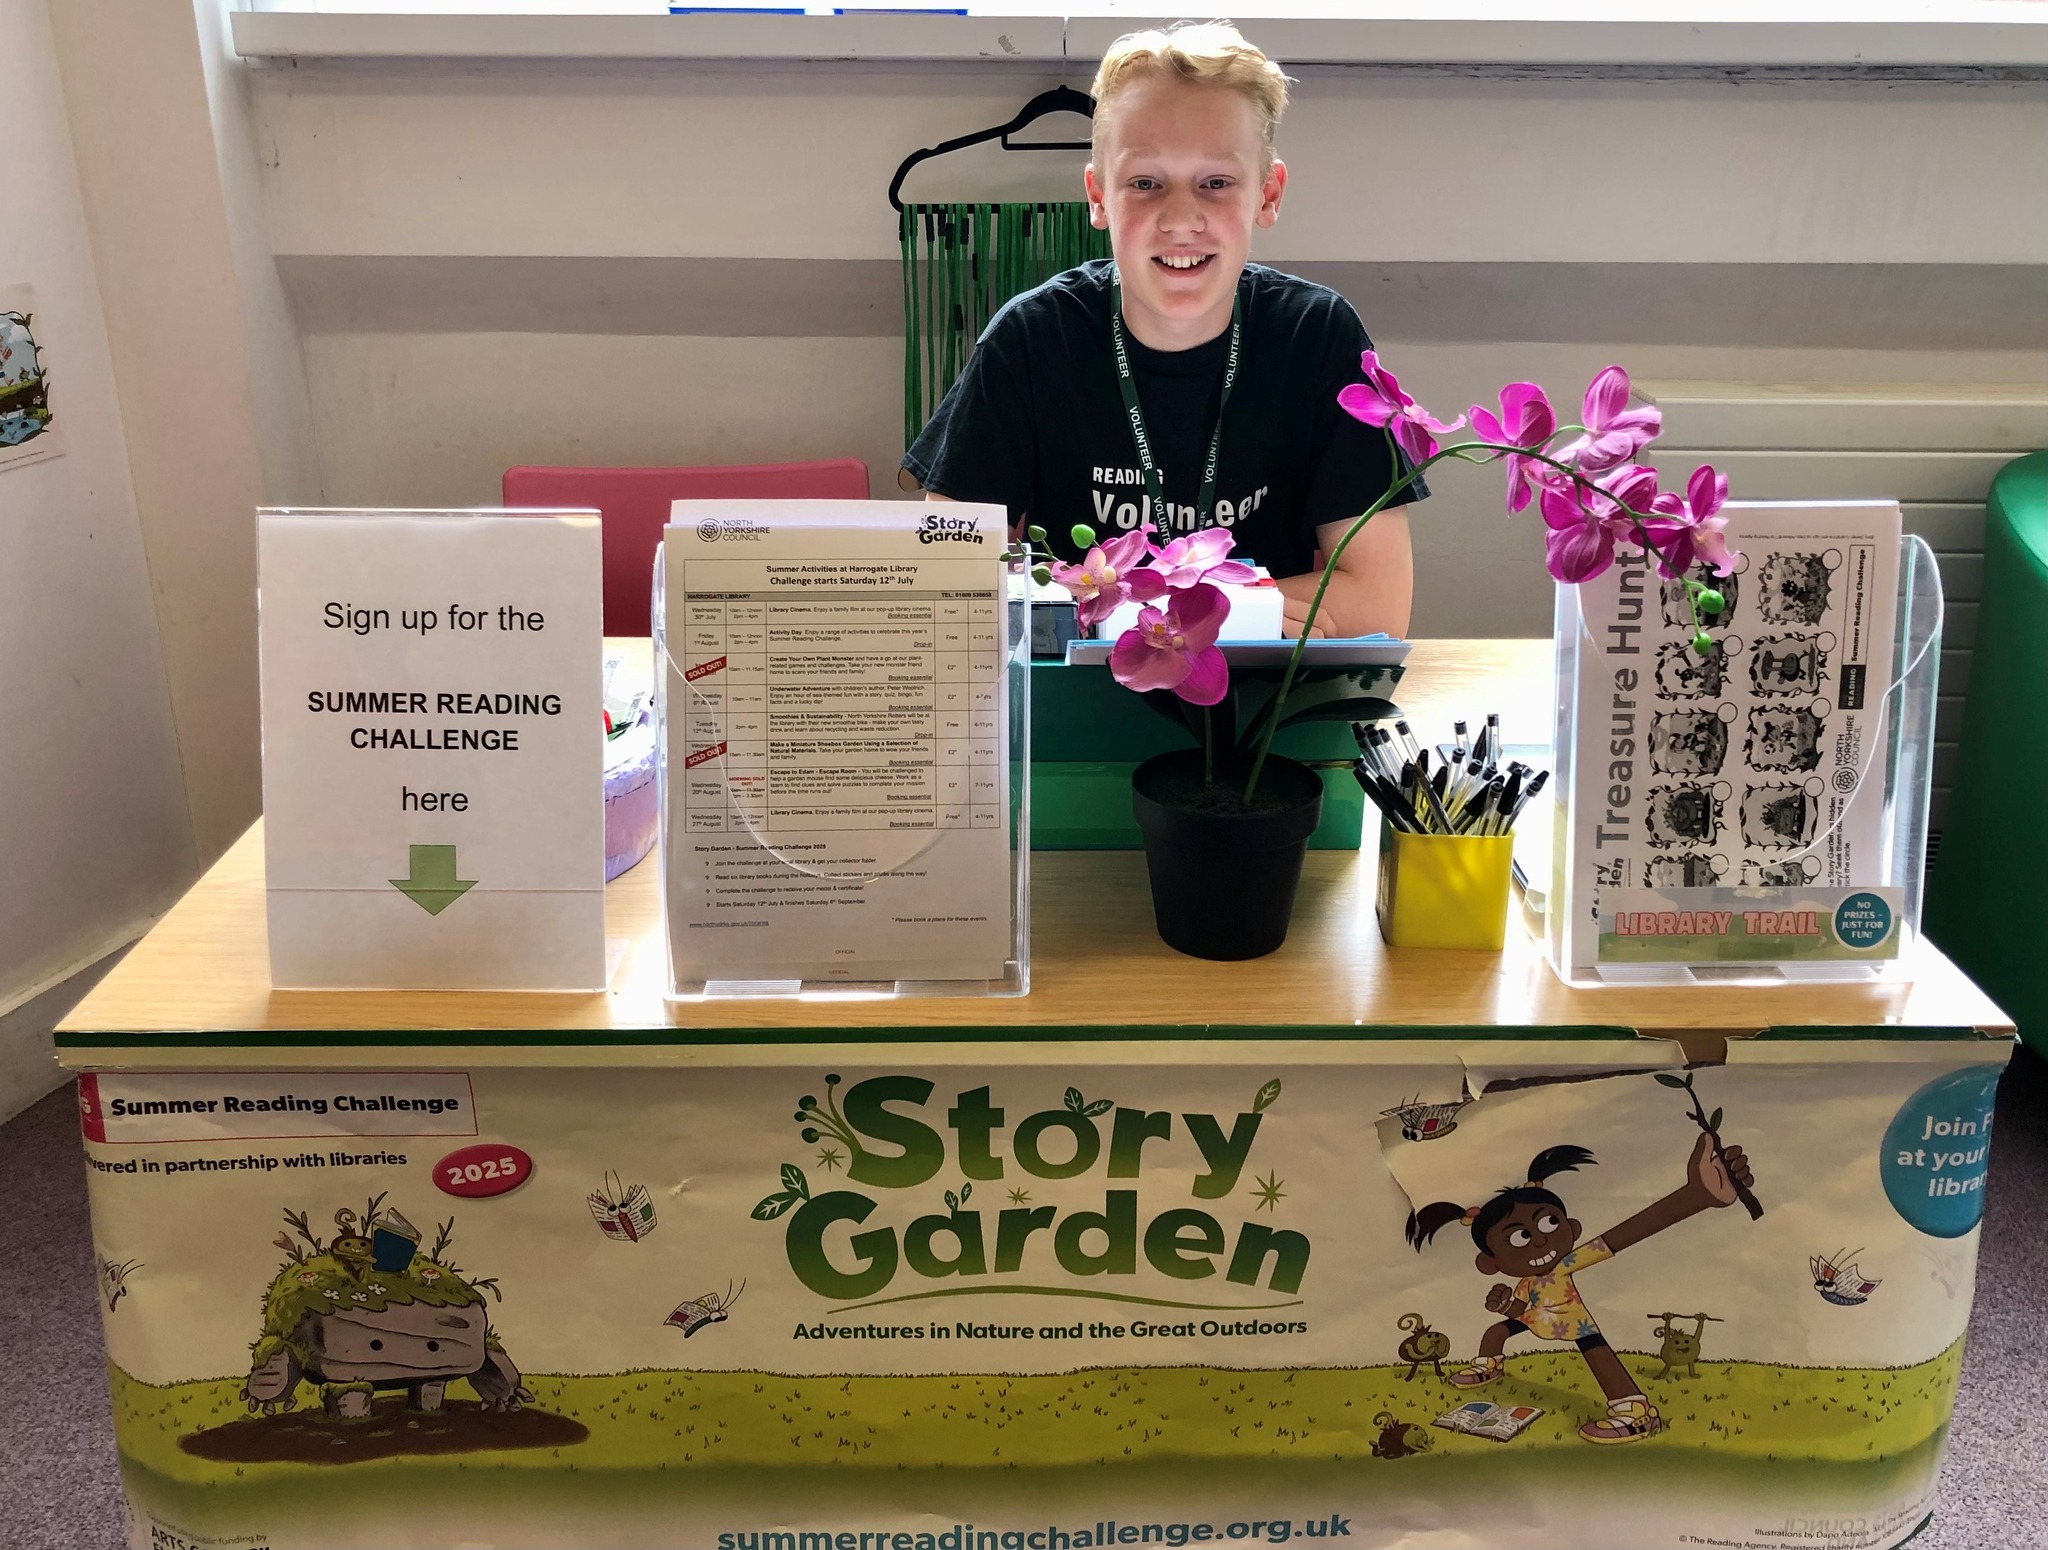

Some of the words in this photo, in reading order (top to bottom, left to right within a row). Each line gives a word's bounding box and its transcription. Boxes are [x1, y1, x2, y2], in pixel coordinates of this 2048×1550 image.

[1112, 312, 1129, 378] VOLUNTEER
[1225, 323, 1240, 388] VOLUNTEER
[1129, 406, 1152, 471] VOLUNTEER
[926, 515, 979, 532] Story
[1154, 496, 1171, 545] VOLUNTE
[919, 530, 983, 544] Garden
[770, 577, 811, 586] Challenge
[840, 577, 877, 585] Saturday
[880, 576, 895, 584] 12th
[898, 577, 914, 585] July
[801, 565, 837, 573] Activities
[890, 565, 917, 573] Library
[1856, 549, 1866, 594] Challenge
[1606, 551, 1648, 654] Hunt
[1854, 592, 1863, 626] Reading
[323, 602, 390, 636] Sign
[402, 606, 438, 636] up
[448, 604, 488, 631] for
[498, 605, 545, 631] the
[688, 667, 706, 679] SOLD
[1848, 668, 1857, 706] READING
[307, 691, 427, 714] SUMMER
[437, 693, 562, 716] READING
[350, 728, 519, 751] CHALLENGE
[1835, 734, 1844, 766] NORTH
[1843, 715, 1855, 766] YORKSHIRE
[1851, 725, 1862, 766] COUNCIL
[689, 753, 706, 764] SOLD
[1596, 668, 1638, 849] Treasure
[401, 786, 469, 812] here
[1615, 911, 1733, 936] LIBRARY
[1743, 911, 1820, 935] TRAIL
[1842, 921, 1862, 929] JUST
[1866, 921, 1883, 929] FOR
[1851, 931, 1873, 939] FUN!
[111, 1099, 218, 1116] Summer
[223, 1094, 328, 1114] Reading
[334, 1096, 459, 1113] Challenge
[840, 1075, 1264, 1199] Story
[1922, 1116, 1977, 1140] Join
[142, 1159, 160, 1172] in
[166, 1154, 279, 1175] partnership
[283, 1153, 325, 1167] with
[330, 1151, 407, 1167] libraries
[1897, 1149, 1926, 1166] at
[446, 1157, 517, 1186] 2025
[785, 1189, 1312, 1300] Garden
[793, 1323, 924, 1339] Adventures
[930, 1323, 950, 1338] in
[956, 1323, 1034, 1339] Nature
[1039, 1323, 1083, 1339] and
[1089, 1323, 1125, 1338] the
[1130, 1321, 1196, 1337] Great
[1200, 1320, 1307, 1336] Outdoors
[219, 1537, 254, 1545] funding
[256, 1534, 267, 1542] by
[717, 1514, 1352, 1550] summerreadingchallenge.org.uk
[1690, 1536, 1705, 1544] The
[1707, 1538, 1742, 1549] Reading
[1755, 1529, 1802, 1538] Illustrations
[1816, 1531, 1839, 1539] Dapo
